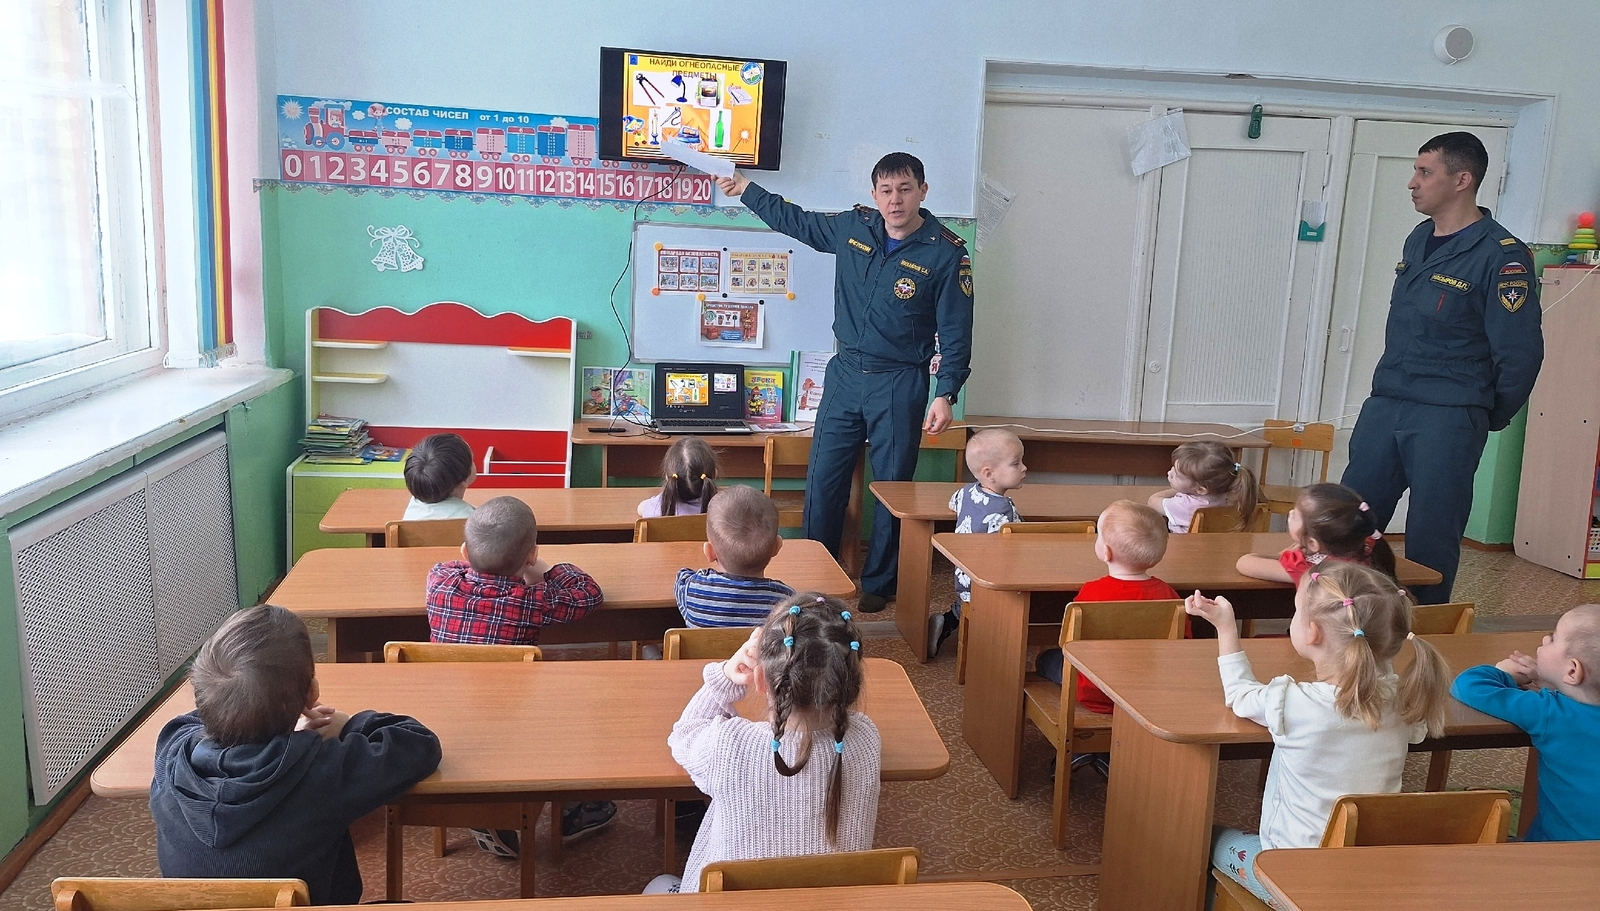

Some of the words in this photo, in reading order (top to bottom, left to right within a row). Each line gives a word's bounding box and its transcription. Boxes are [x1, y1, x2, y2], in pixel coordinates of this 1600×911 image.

[679, 61, 740, 71] ОГНЕОПАСНЫЕ
[672, 70, 717, 79] ПРЕДМЕТЫ
[386, 106, 429, 117] СОСТАВ
[432, 109, 469, 120] ЧИСЕЛ
[517, 116, 530, 124] 10
[285, 154, 303, 178] 0
[309, 155, 321, 179] 1
[328, 156, 345, 180] 2
[350, 157, 367, 181] 3
[370, 159, 389, 183] 4
[393, 160, 409, 184] 5
[413, 161, 431, 185] 6
[434, 163, 451, 186] 7
[454, 163, 473, 187] 8
[476, 165, 493, 188] 9
[495, 167, 515, 190] 10
[517, 168, 534, 191] 11
[537, 169, 556, 193] 12
[557, 171, 575, 194] 13
[577, 172, 595, 195] 14
[596, 173, 615, 196] 15
[616, 174, 635, 197] 16
[636, 175, 655, 198] 17
[655, 176, 673, 199] 18
[674, 177, 692, 200] 19
[693, 179, 711, 200] 20
